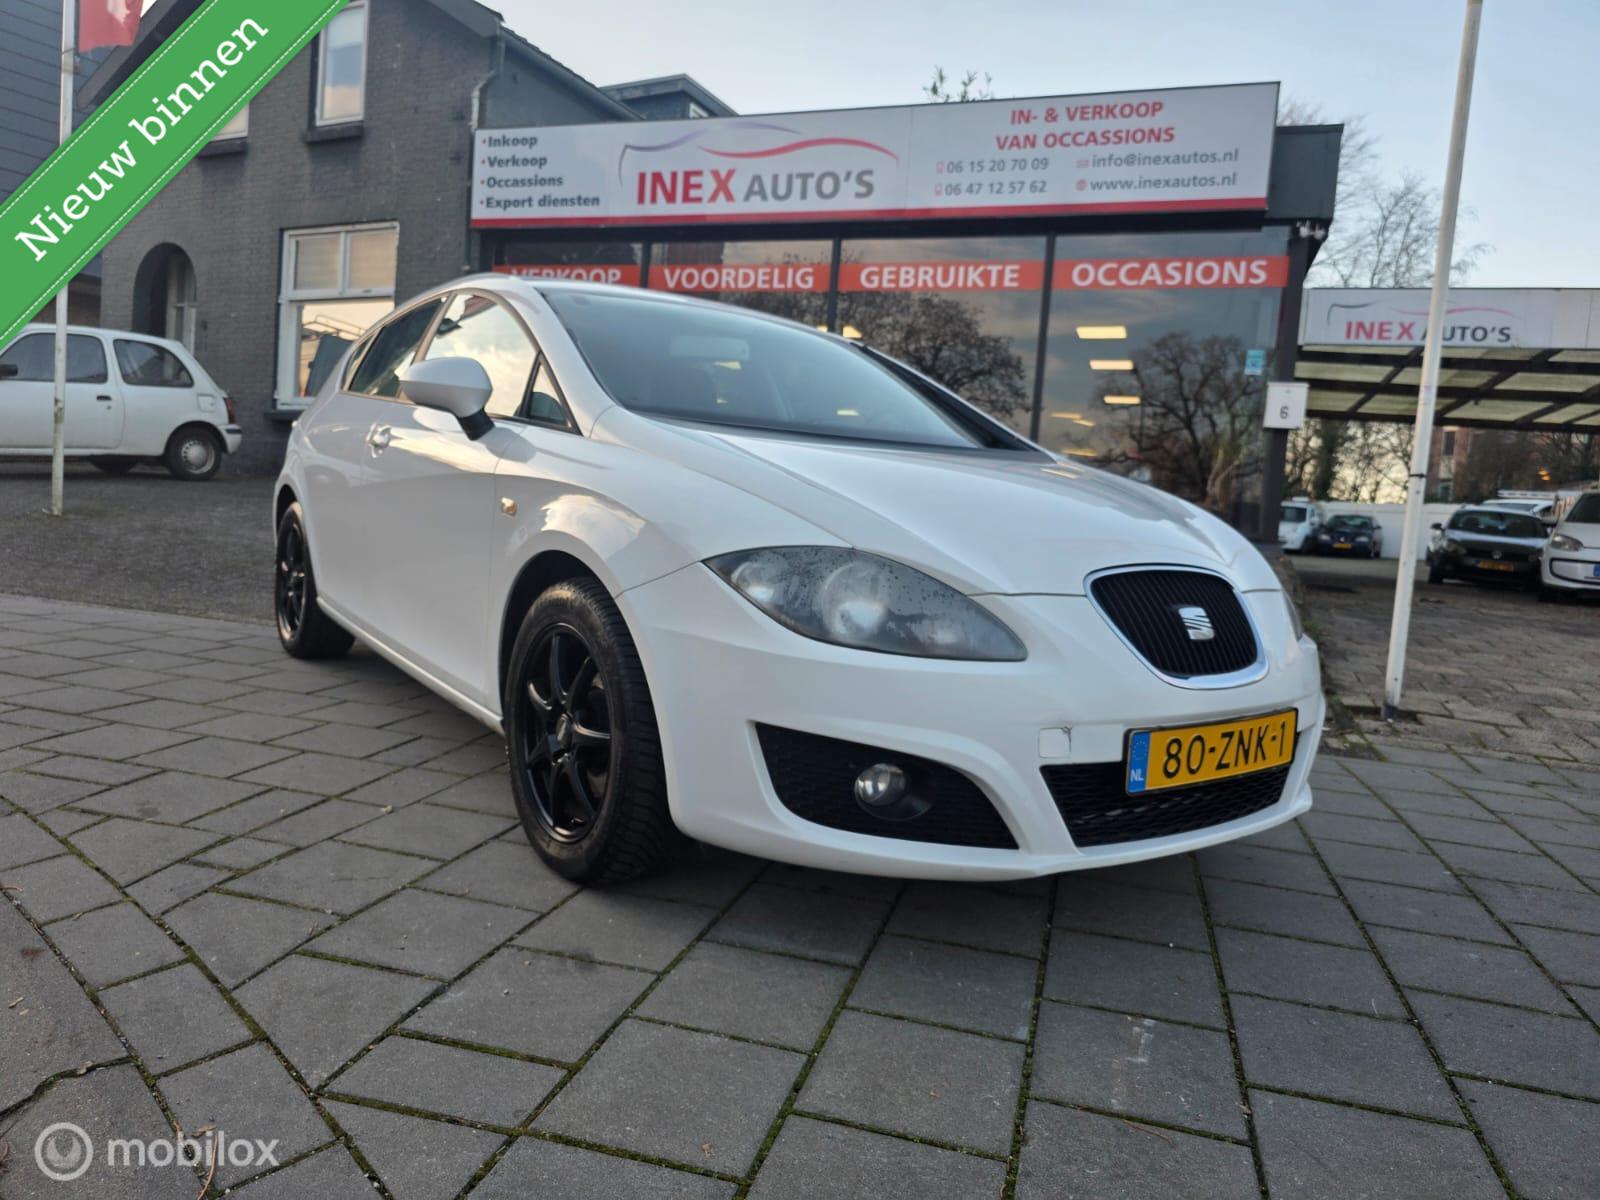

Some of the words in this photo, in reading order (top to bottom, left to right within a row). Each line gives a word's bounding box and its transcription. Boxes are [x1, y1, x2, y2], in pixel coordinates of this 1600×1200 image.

[1010, 109, 1037, 125] IN-
[1043, 107, 1059, 123] &
[1065, 101, 1164, 122] VERKOOP
[488, 136, 538, 149] Inkoop
[996, 133, 1037, 151] VAN
[1043, 127, 1176, 149] OCCASSIONS
[487, 155, 547, 169] Verkoop
[946, 161, 963, 174] 06
[969, 160, 984, 173] 15
[988, 160, 1006, 172] 20
[1010, 159, 1027, 171] 70
[1031, 158, 1049, 170] 09
[1092, 148, 1239, 168] info@inexautos.nl
[486, 174, 564, 188] Occassions
[636, 168, 737, 205] INEX
[743, 169, 875, 201] AUTO'S
[945, 183, 961, 196] 06
[966, 183, 982, 195] 47
[988, 182, 1004, 194] 12
[1008, 181, 1025, 194] 57
[1029, 180, 1047, 193] 62
[1089, 172, 1237, 191] www.inexautos.nl
[486, 196, 533, 211] Export
[538, 194, 600, 207] diensten
[664, 267, 814, 290] VOORDELIG
[860, 263, 1021, 289] GEBRUIKTE
[1071, 260, 1268, 287] OCCASIONS
[1344, 320, 1416, 341] INEX
[1420, 326, 1511, 343] UTO'S
[1280, 405, 1289, 419] 6
[1130, 769, 1145, 782] NL
[1162, 720, 1287, 780] 80-ZNK-1
